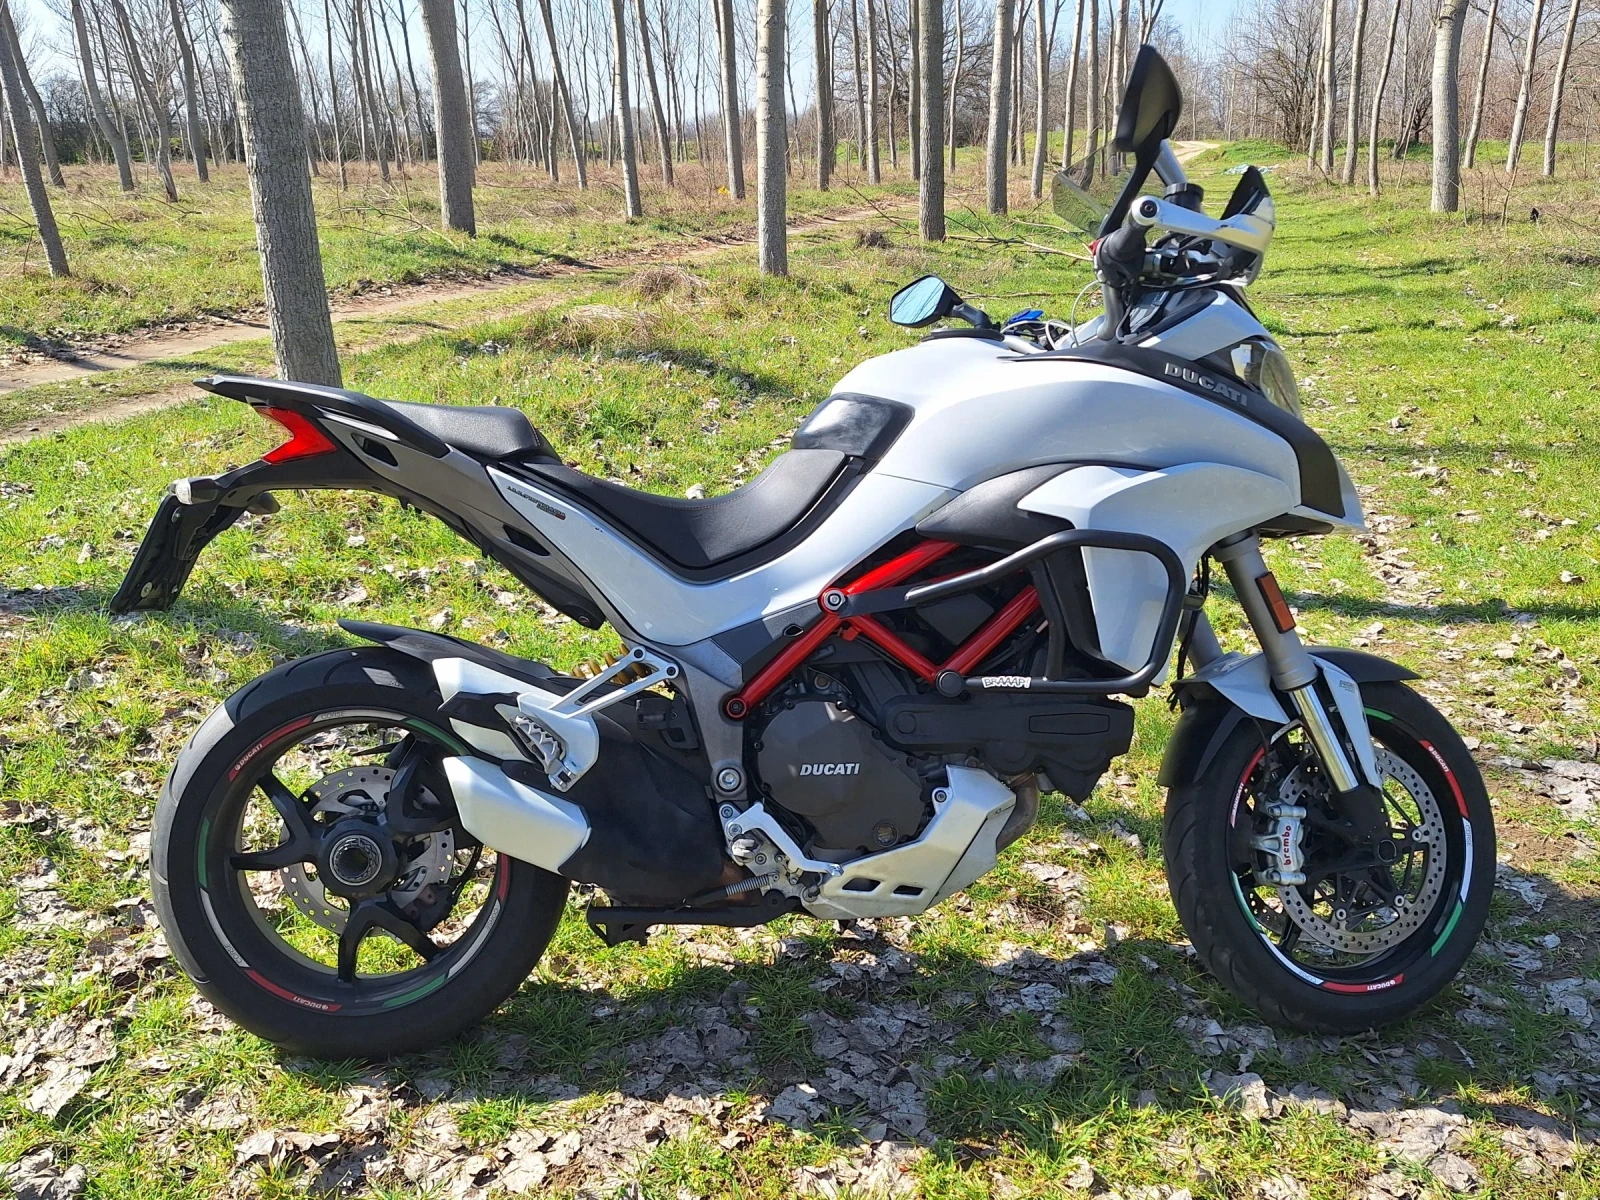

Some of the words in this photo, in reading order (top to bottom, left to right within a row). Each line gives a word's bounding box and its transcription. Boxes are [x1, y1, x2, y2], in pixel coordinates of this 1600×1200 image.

[1164, 362, 1248, 407] DUCATI
[983, 677, 1031, 688] BRAAAP!
[240, 743, 263, 766] DUCATI
[1432, 750, 1449, 772] DUCATI
[800, 763, 860, 776] DUCATI
[1367, 981, 1390, 991] DUCATI
[293, 996, 322, 1008] DUCATI
